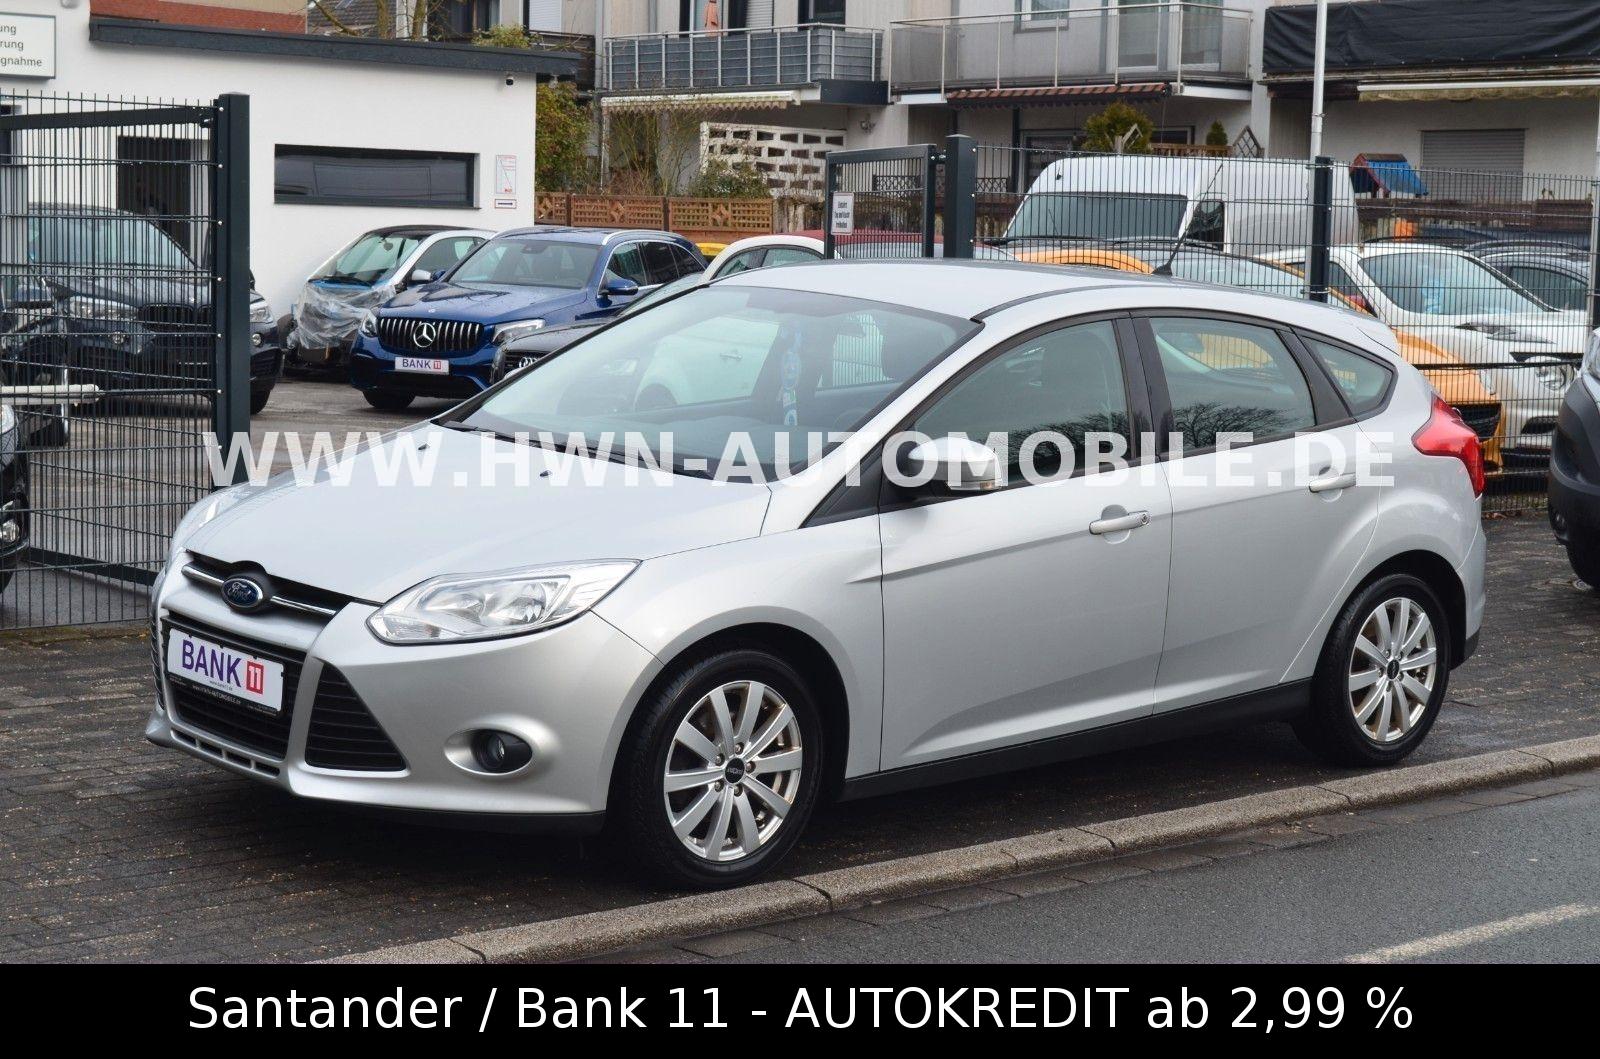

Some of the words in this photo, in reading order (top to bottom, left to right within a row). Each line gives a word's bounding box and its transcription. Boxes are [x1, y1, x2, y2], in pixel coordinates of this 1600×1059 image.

[0, 56, 42, 67] gnahme
[402, 358, 431, 369] BANK
[182, 639, 242, 688] BANK
[247, 662, 263, 693] 11
